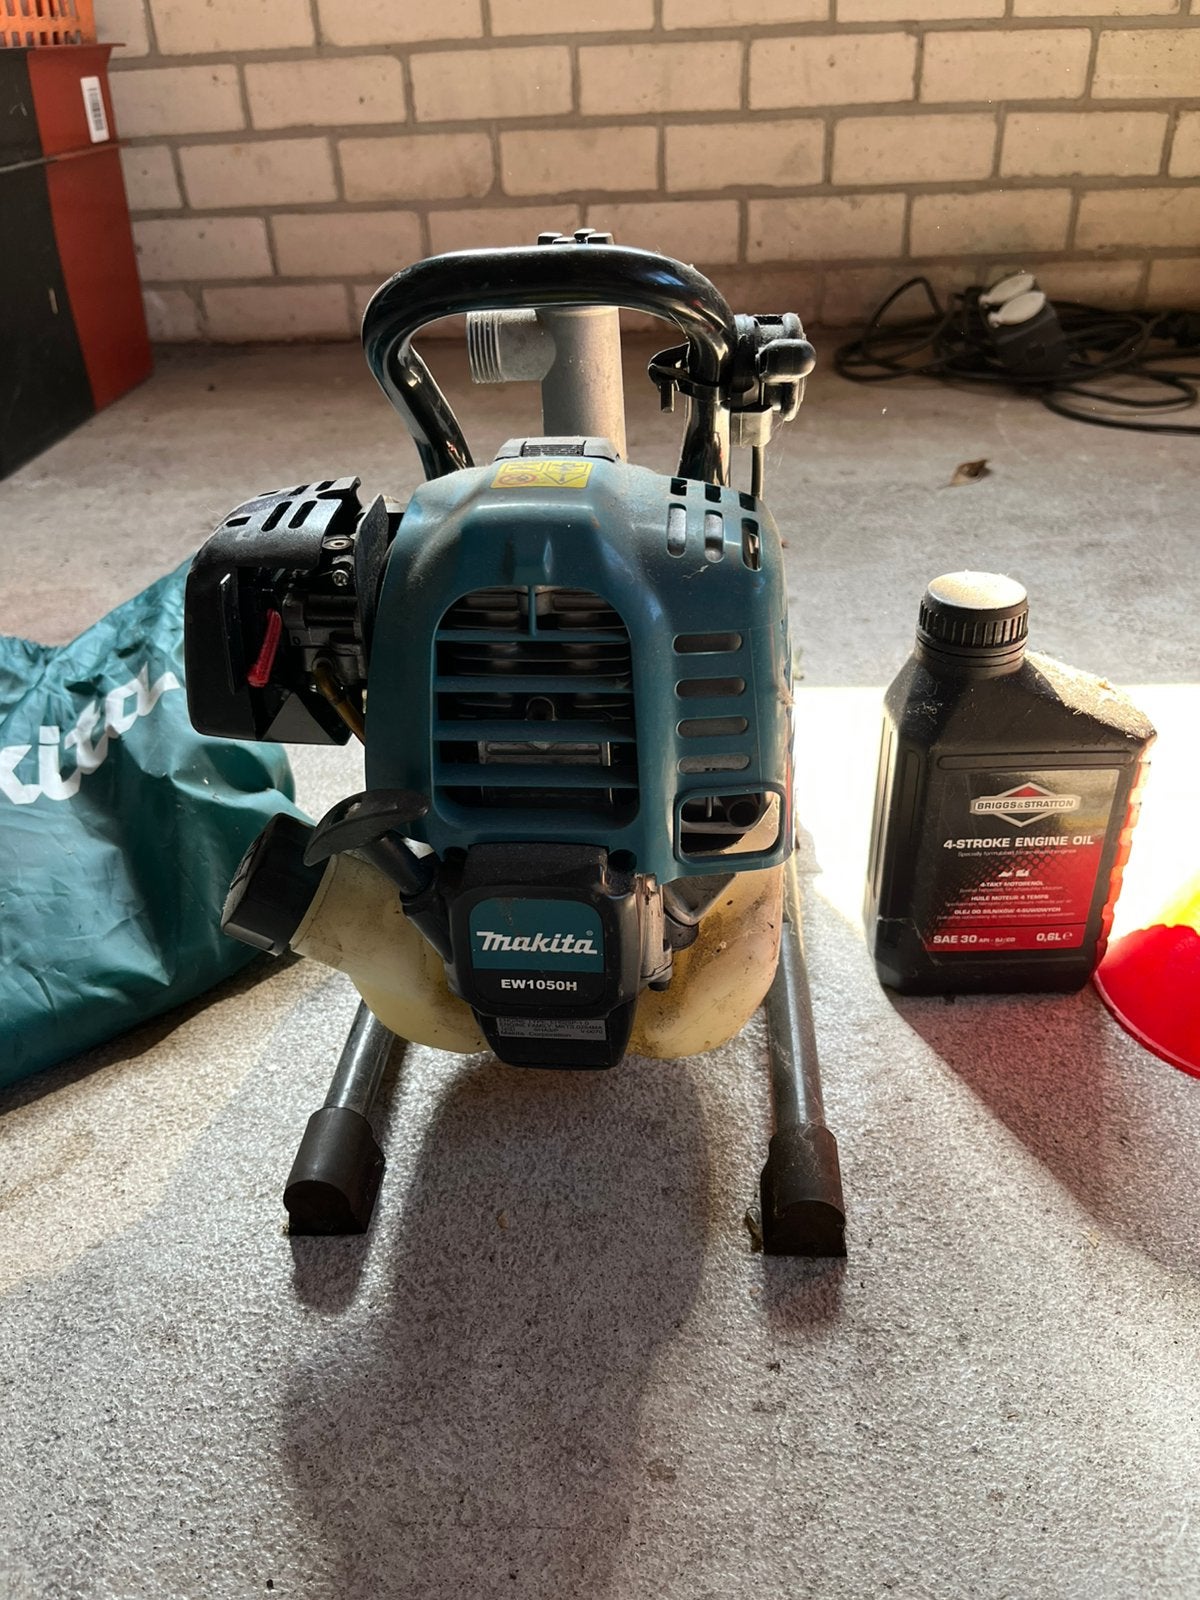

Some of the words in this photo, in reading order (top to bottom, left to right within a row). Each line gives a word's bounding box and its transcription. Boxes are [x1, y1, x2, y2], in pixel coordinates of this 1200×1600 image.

[976, 799, 1074, 811] BRIGGS&STRATTON
[943, 837, 1011, 849] 4-STROKE
[1015, 836, 1068, 847] ENGINE
[1072, 835, 1095, 846] OIL
[476, 931, 598, 955] Makita
[933, 935, 959, 944] SAE
[960, 934, 977, 944] 30
[500, 978, 578, 991] EW1050H
